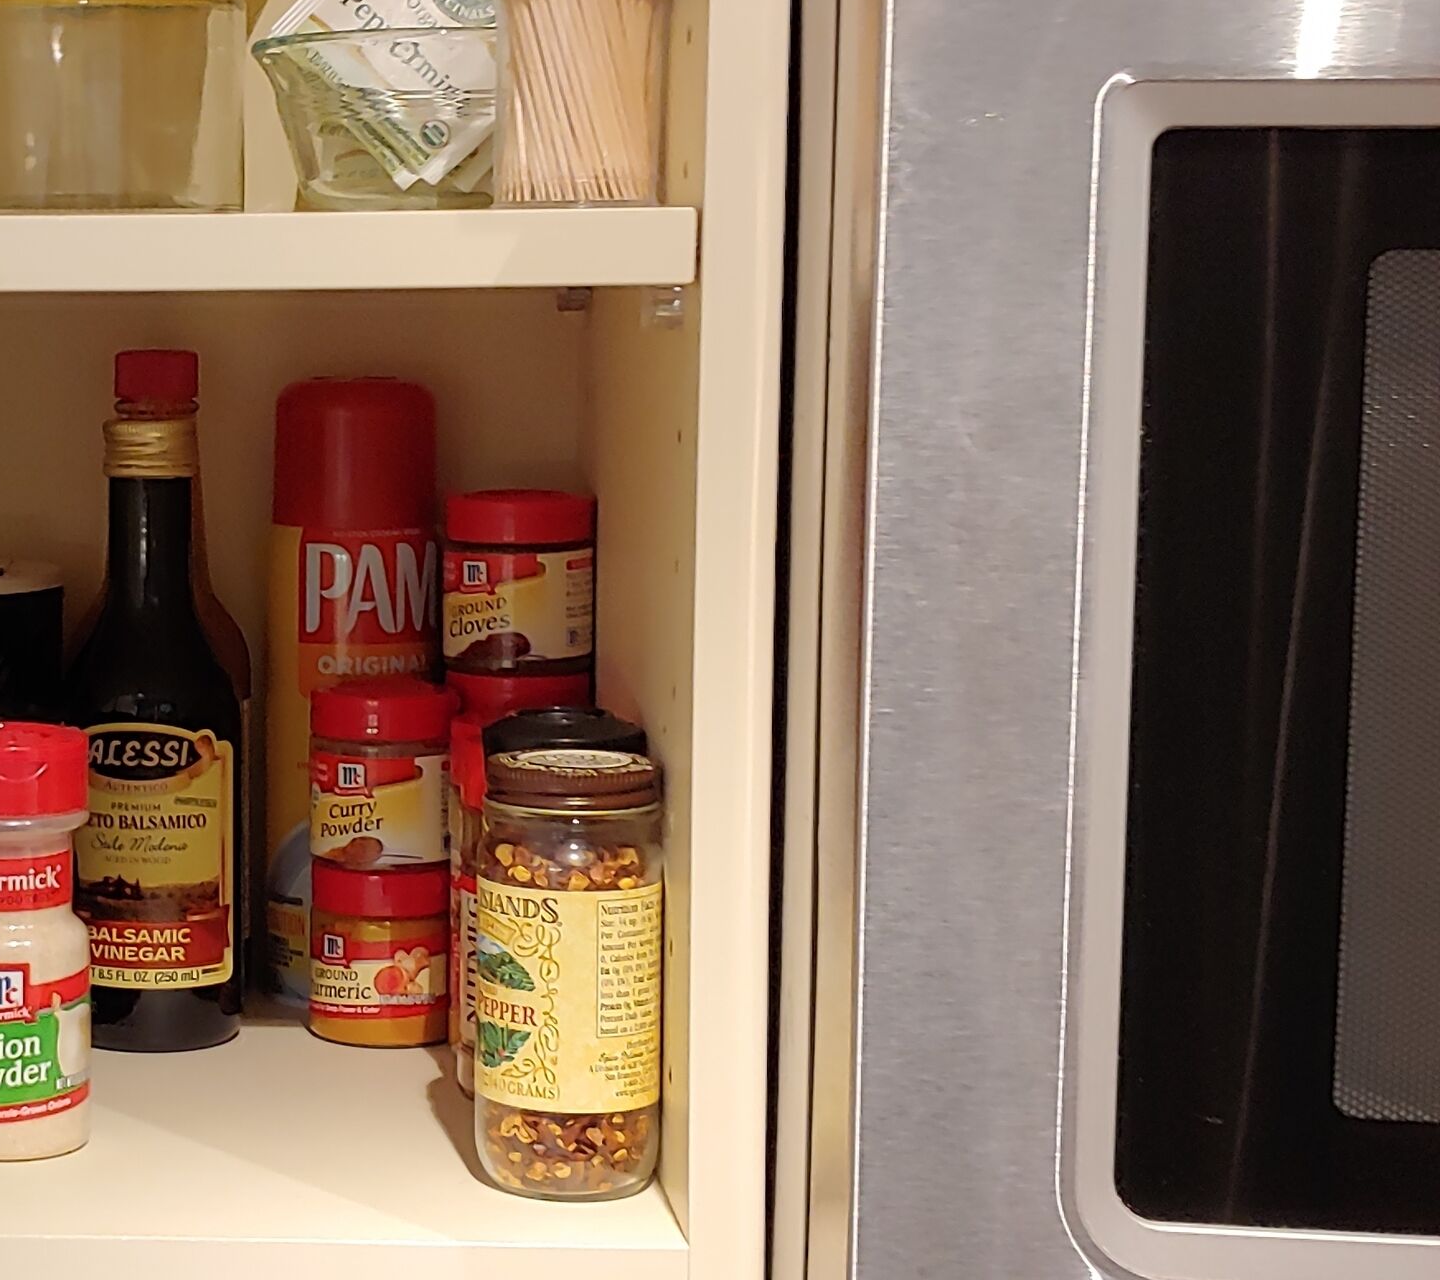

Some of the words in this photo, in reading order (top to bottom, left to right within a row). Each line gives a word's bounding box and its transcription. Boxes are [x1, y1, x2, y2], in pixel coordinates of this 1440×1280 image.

[304, 540, 439, 634] PAM
[449, 614, 511, 638] Cloves
[317, 652, 427, 676] ORIGINA
[88, 738, 189, 767] ALESSI
[111, 801, 161, 811] PREMIUM
[329, 801, 377, 820] Curry
[87, 813, 114, 829] ETO
[119, 813, 207, 831] BALSAMICO
[320, 817, 384, 838] Powder
[88, 925, 192, 944] BALSAMIC
[91, 943, 186, 961] VINEGAR
[98, 969, 113, 980] 8.5
[154, 970, 178, 984] (250
[181, 969, 200, 982] mL)
[314, 967, 359, 982] GROUND
